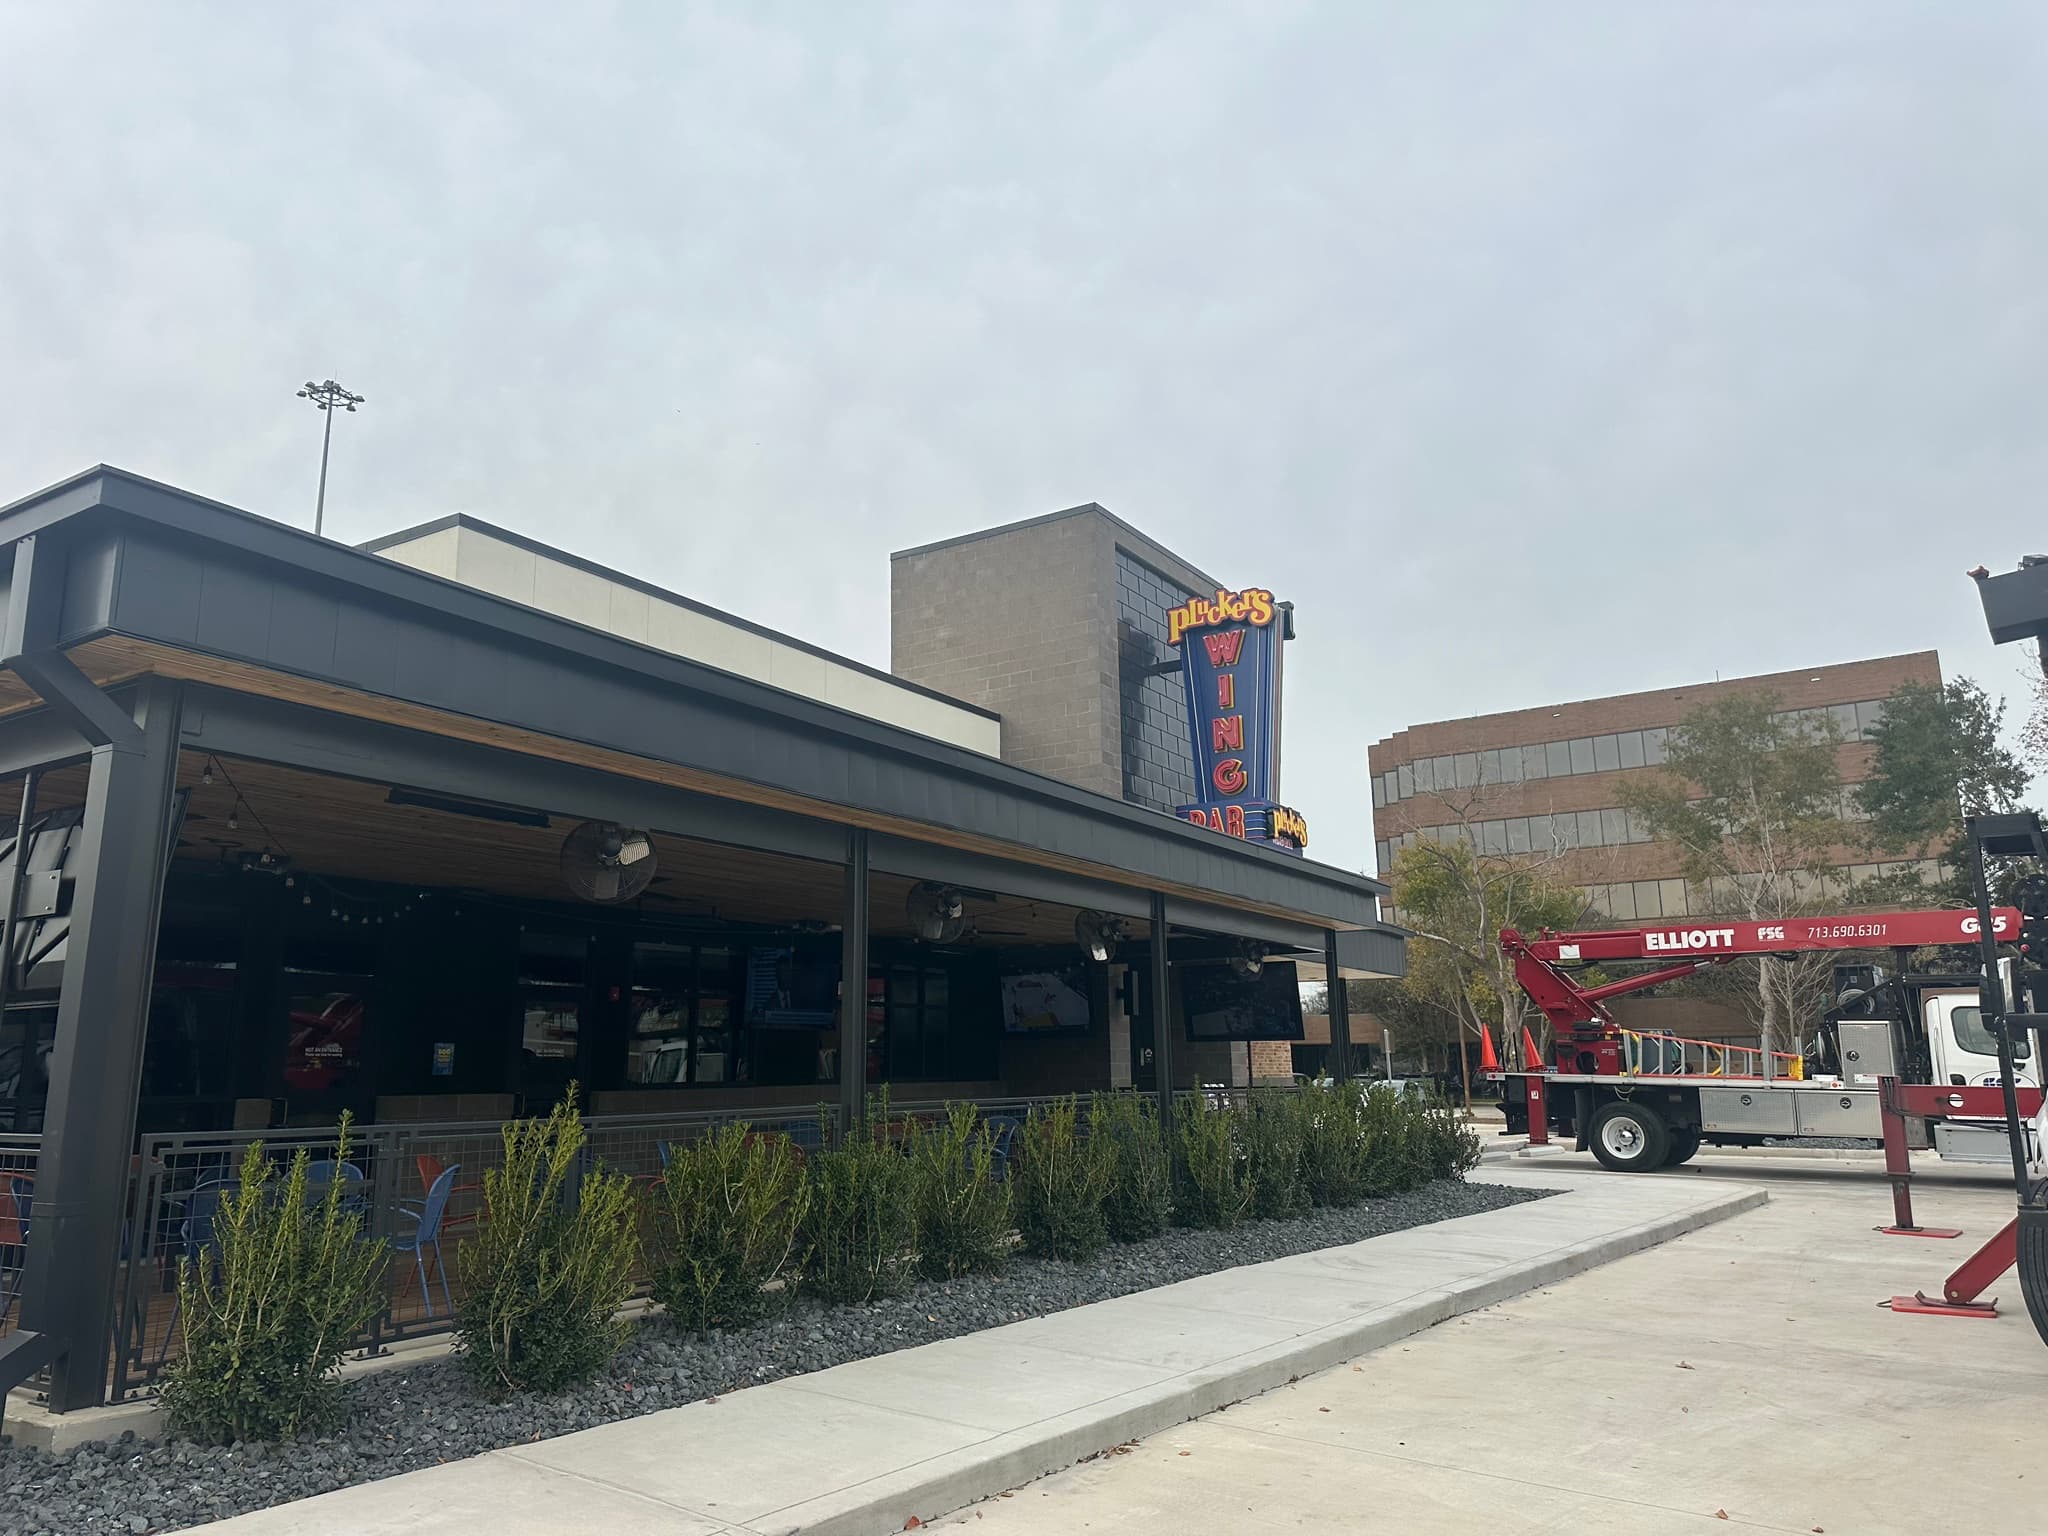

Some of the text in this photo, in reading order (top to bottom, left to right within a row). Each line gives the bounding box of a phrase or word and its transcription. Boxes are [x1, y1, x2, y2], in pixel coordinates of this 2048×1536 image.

[1203, 629, 1247, 796] WING
[1757, 926, 1785, 940] FSG
[1808, 924, 1888, 939] 713.690.6301
[1960, 916, 2007, 934] G5
[1645, 929, 1735, 950] ELLIOTT
